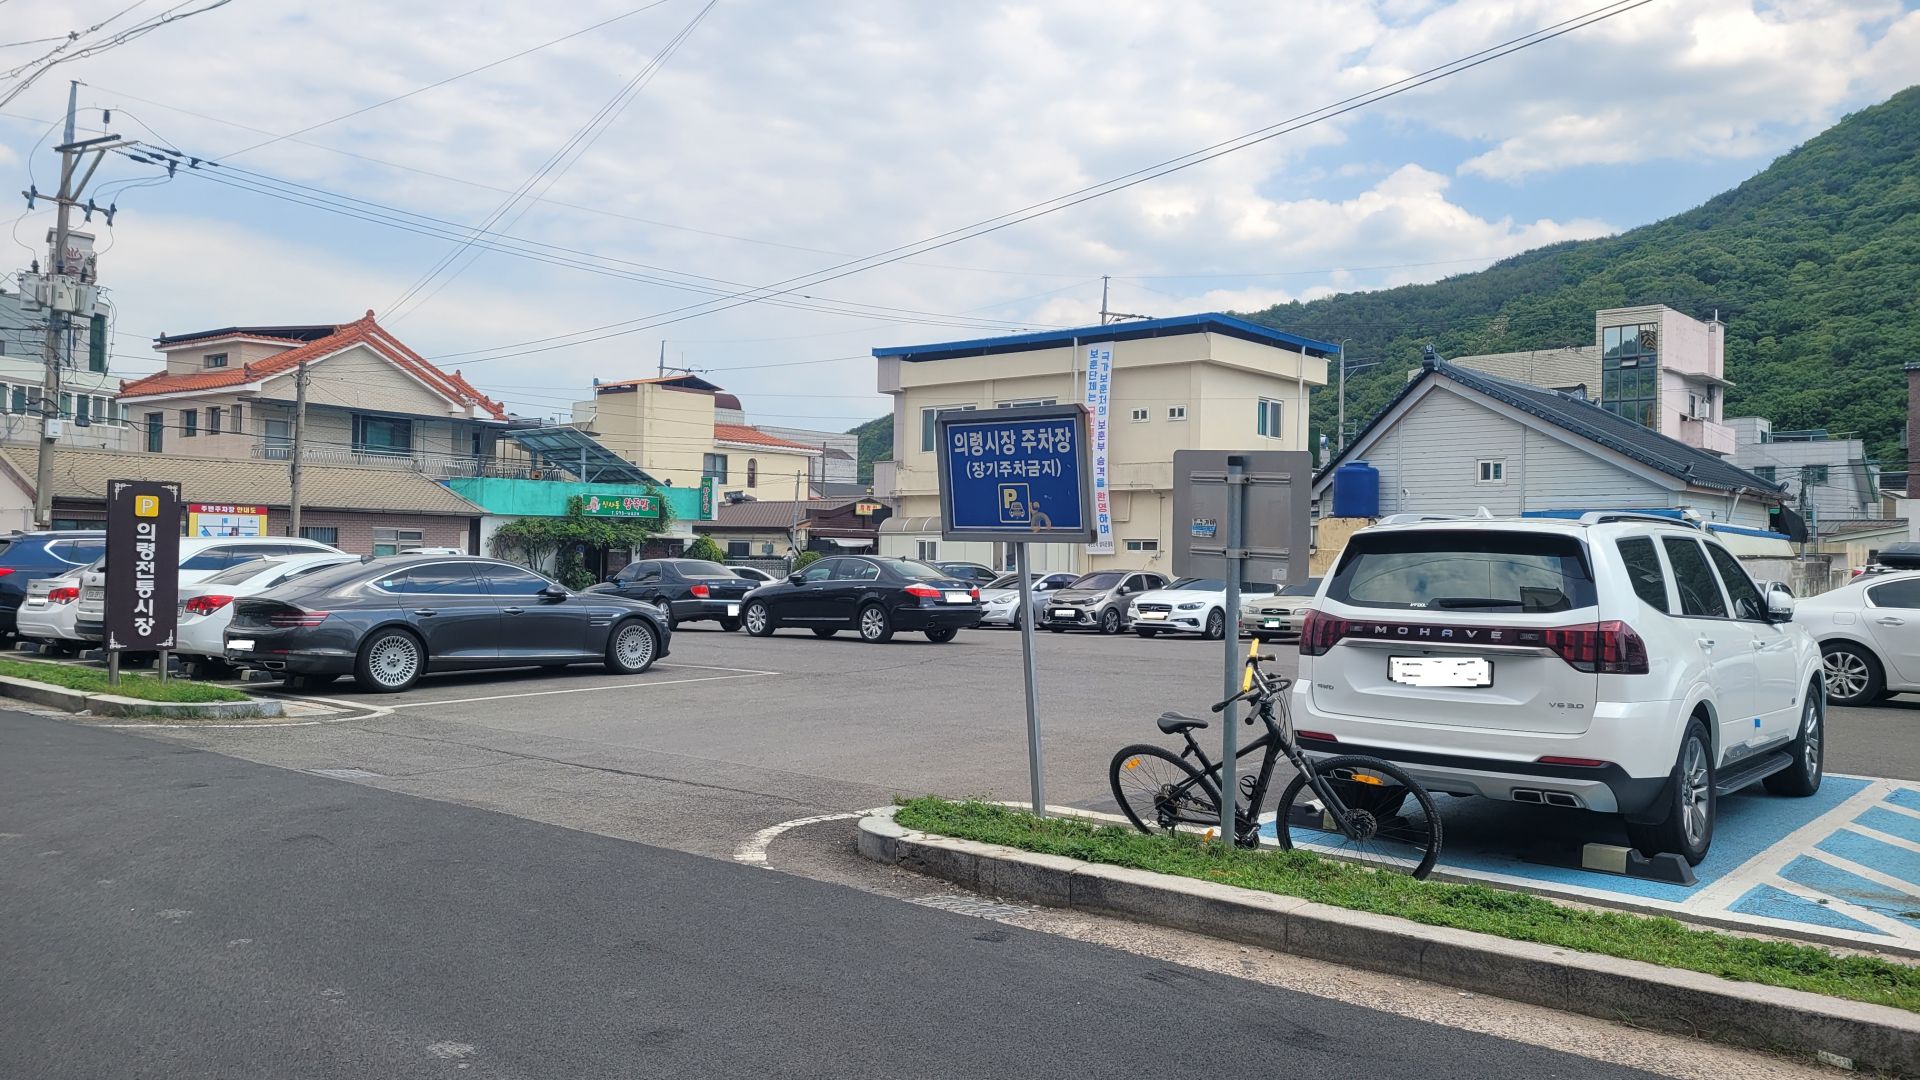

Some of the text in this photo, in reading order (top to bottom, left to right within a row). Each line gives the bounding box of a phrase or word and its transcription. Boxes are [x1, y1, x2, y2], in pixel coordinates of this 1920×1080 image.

[1088, 348, 1099, 402] 보훈단체는
[954, 430, 1016, 456] 의령시장
[1021, 426, 1072, 454] 주차장
[1097, 420, 1106, 451] 보훈부
[966, 458, 1062, 479] (장기주차금지)
[141, 498, 154, 514] P
[623, 497, 650, 511] 왕족발
[1003, 488, 1018, 509] P
[236, 506, 257, 514] 안내도
[1097, 491, 1110, 534] 환영하며
[134, 522, 157, 637] 의령전통시장
[1374, 625, 1503, 640] MOHAVE
